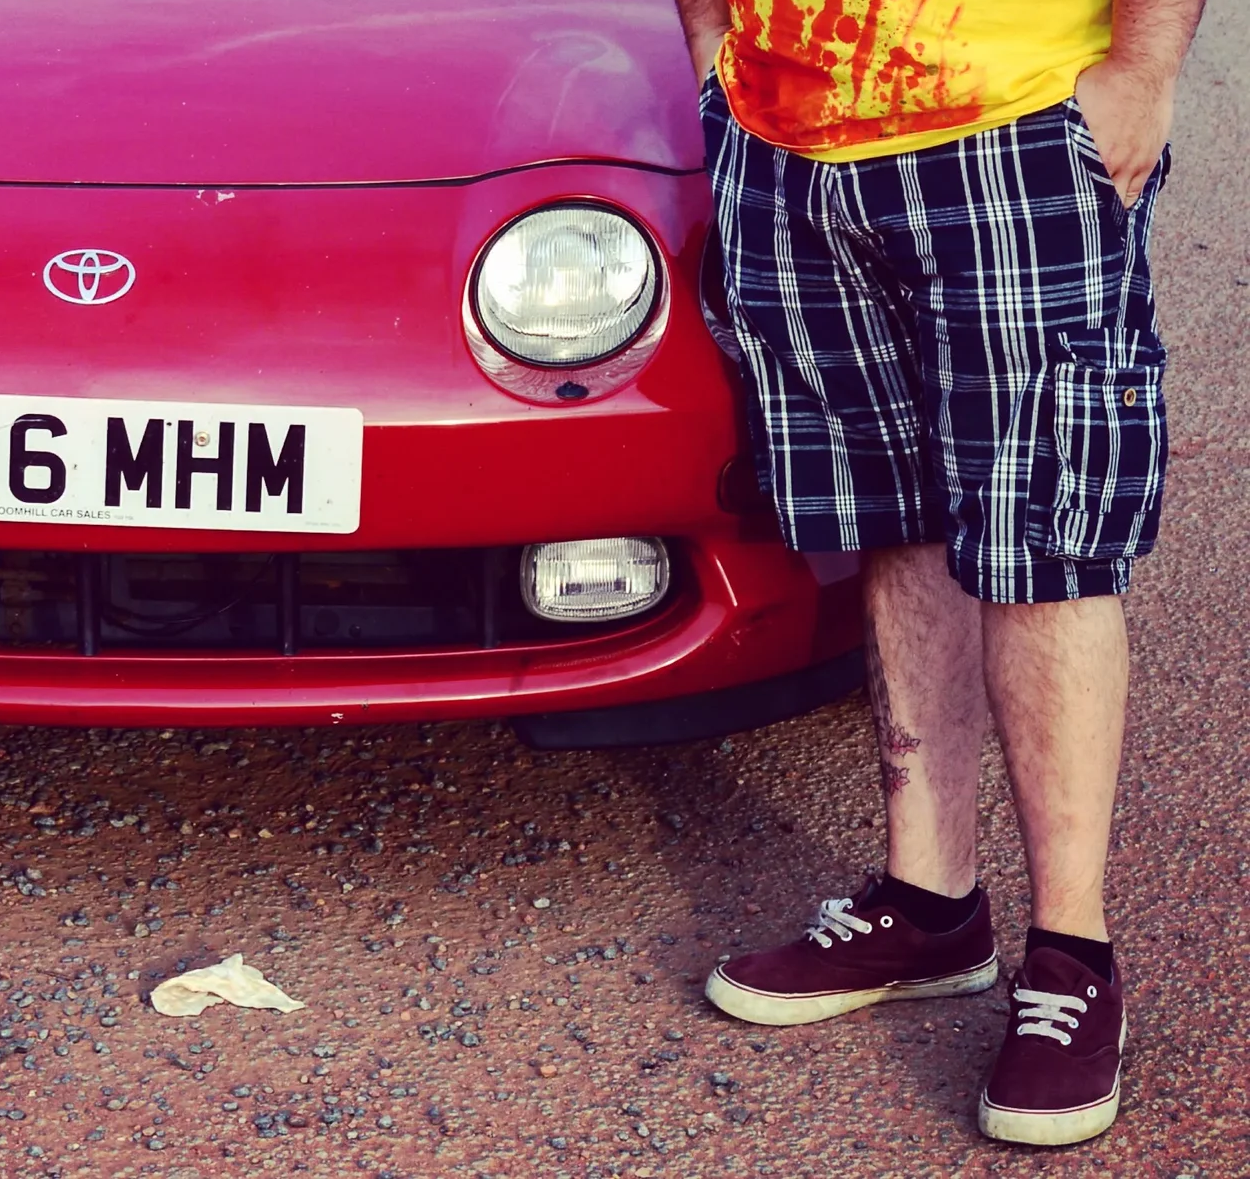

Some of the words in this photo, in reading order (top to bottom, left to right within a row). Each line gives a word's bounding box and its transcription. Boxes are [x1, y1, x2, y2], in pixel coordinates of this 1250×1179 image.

[104, 417, 306, 514] MHM
[50, 509, 73, 518] CAR
[76, 509, 111, 519] SALES
